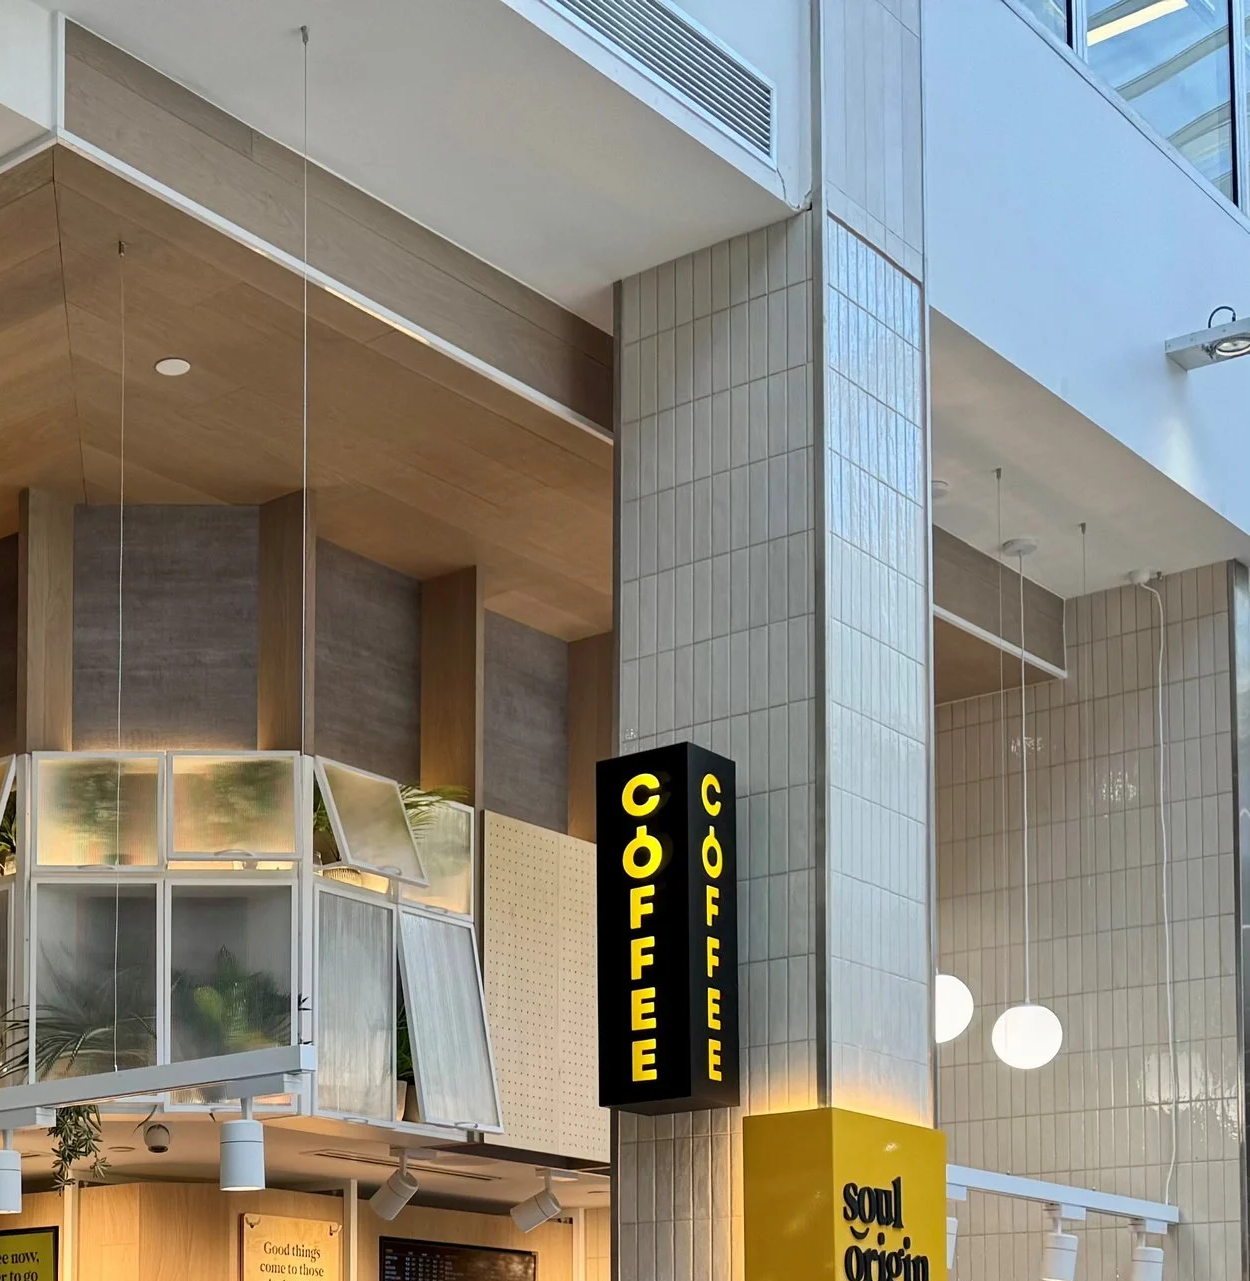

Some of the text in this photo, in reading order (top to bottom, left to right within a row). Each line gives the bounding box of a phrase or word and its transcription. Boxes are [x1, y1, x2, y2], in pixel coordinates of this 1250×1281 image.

[621, 773, 663, 1082] COFFEE
[701, 773, 723, 1082] COFFEE
[843, 1176, 904, 1229] soul
[10, 1251, 39, 1264] now,
[260, 1263, 324, 1277] come to those
[264, 1241, 320, 1263] Good things
